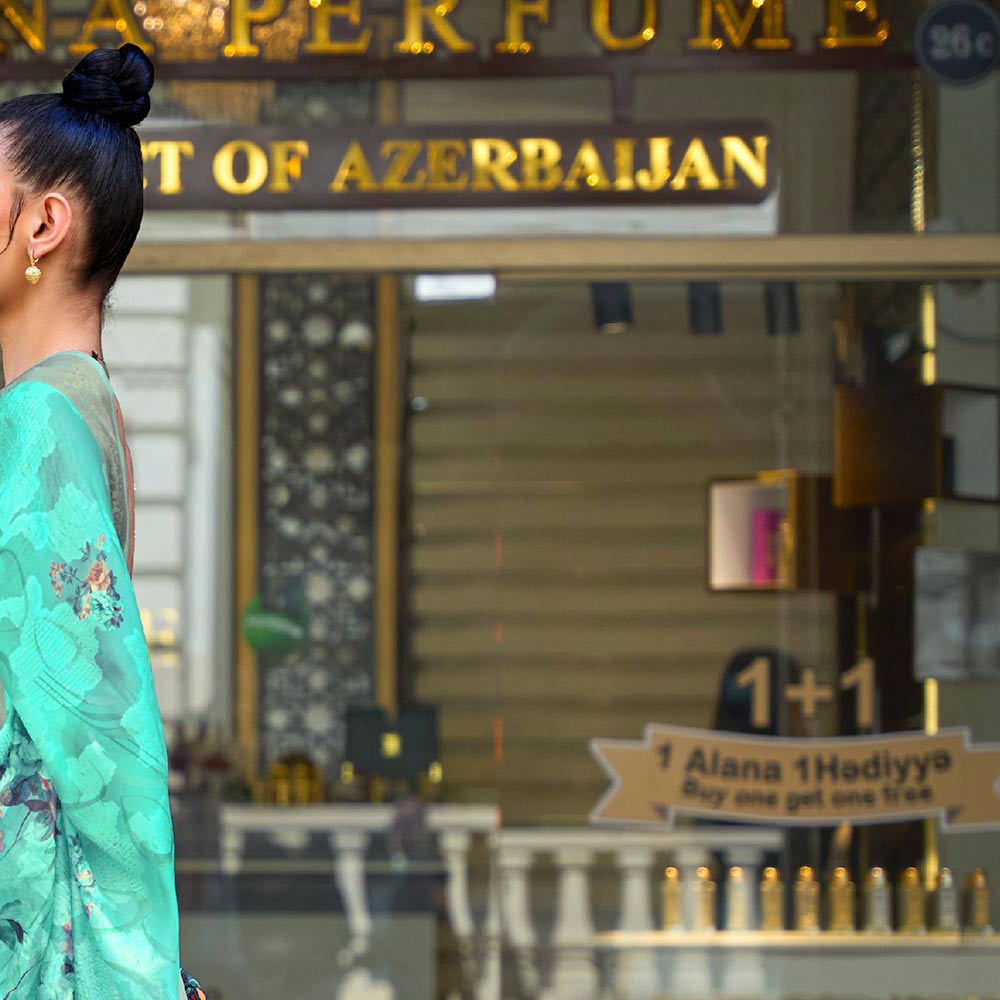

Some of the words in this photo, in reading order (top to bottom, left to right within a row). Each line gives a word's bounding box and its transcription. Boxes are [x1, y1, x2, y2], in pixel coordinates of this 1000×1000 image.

[223, 0, 890, 57] PERFUME
[212, 139, 309, 195] OF
[330, 135, 769, 193] AZERBAIJAN
[737, 657, 875, 728] 1+1
[684, 778, 726, 807] Buy
[685, 747, 781, 782] Alana
